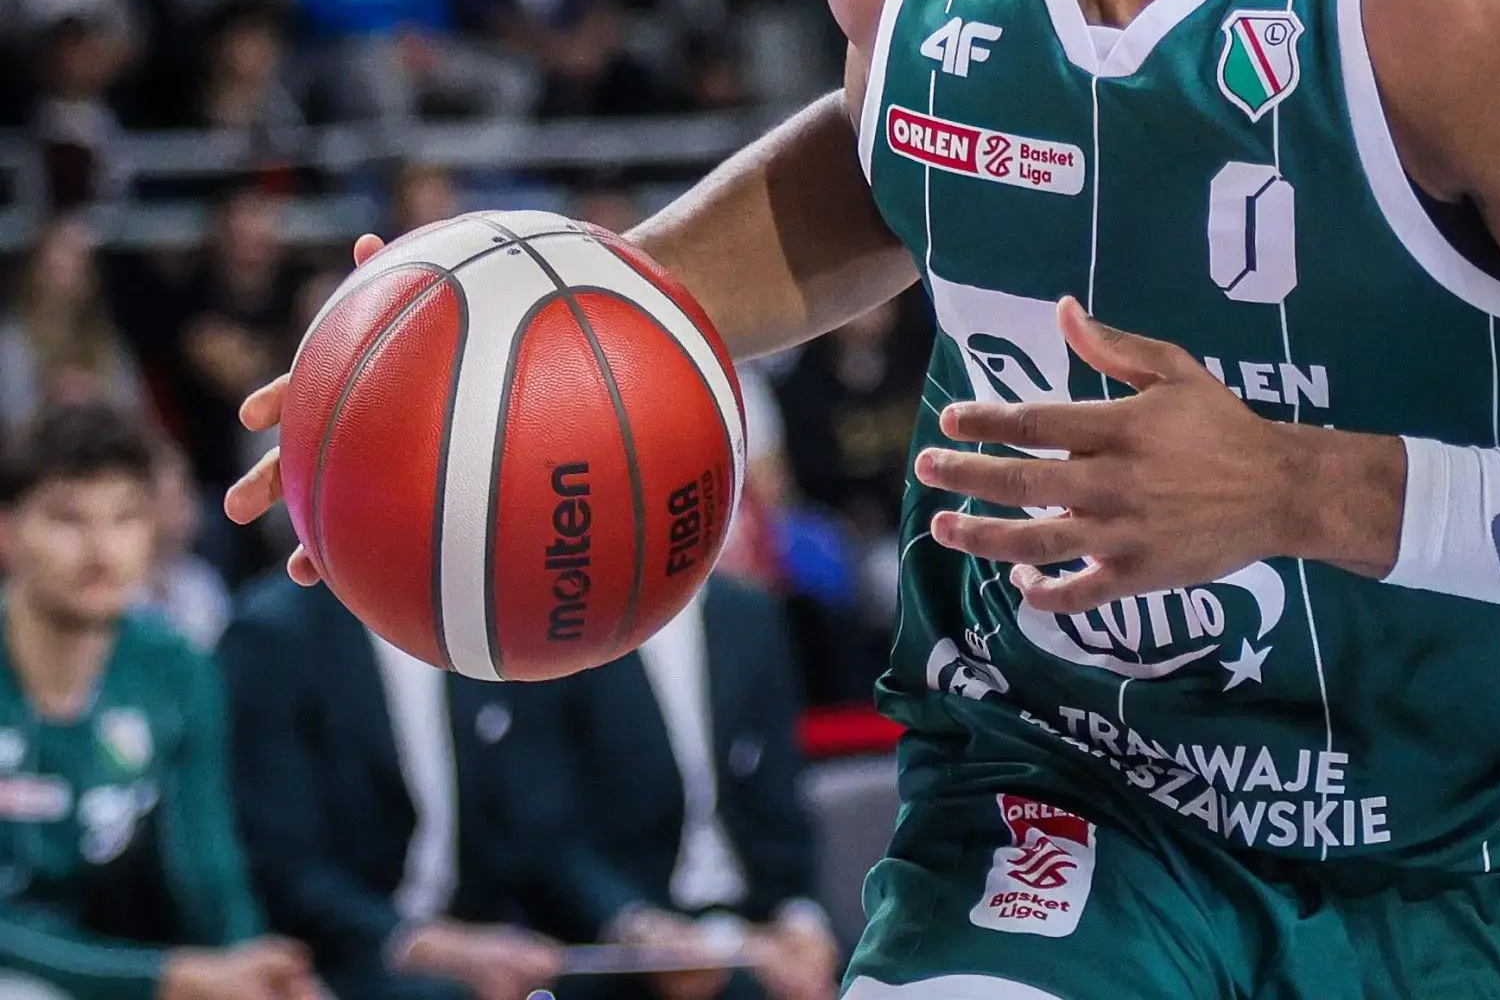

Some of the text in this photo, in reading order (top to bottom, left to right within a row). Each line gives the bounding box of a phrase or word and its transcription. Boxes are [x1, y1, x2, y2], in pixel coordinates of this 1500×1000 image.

[921, 16, 1002, 77] 4F
[893, 118, 970, 162] ORLEN
[1020, 143, 1074, 168] Basket
[1019, 162, 1052, 185] Liga
[1208, 161, 1298, 304] 0
[665, 479, 700, 577] FIBA
[545, 461, 592, 641] molten
[989, 891, 1070, 912] Basket
[998, 903, 1048, 920] Liga
